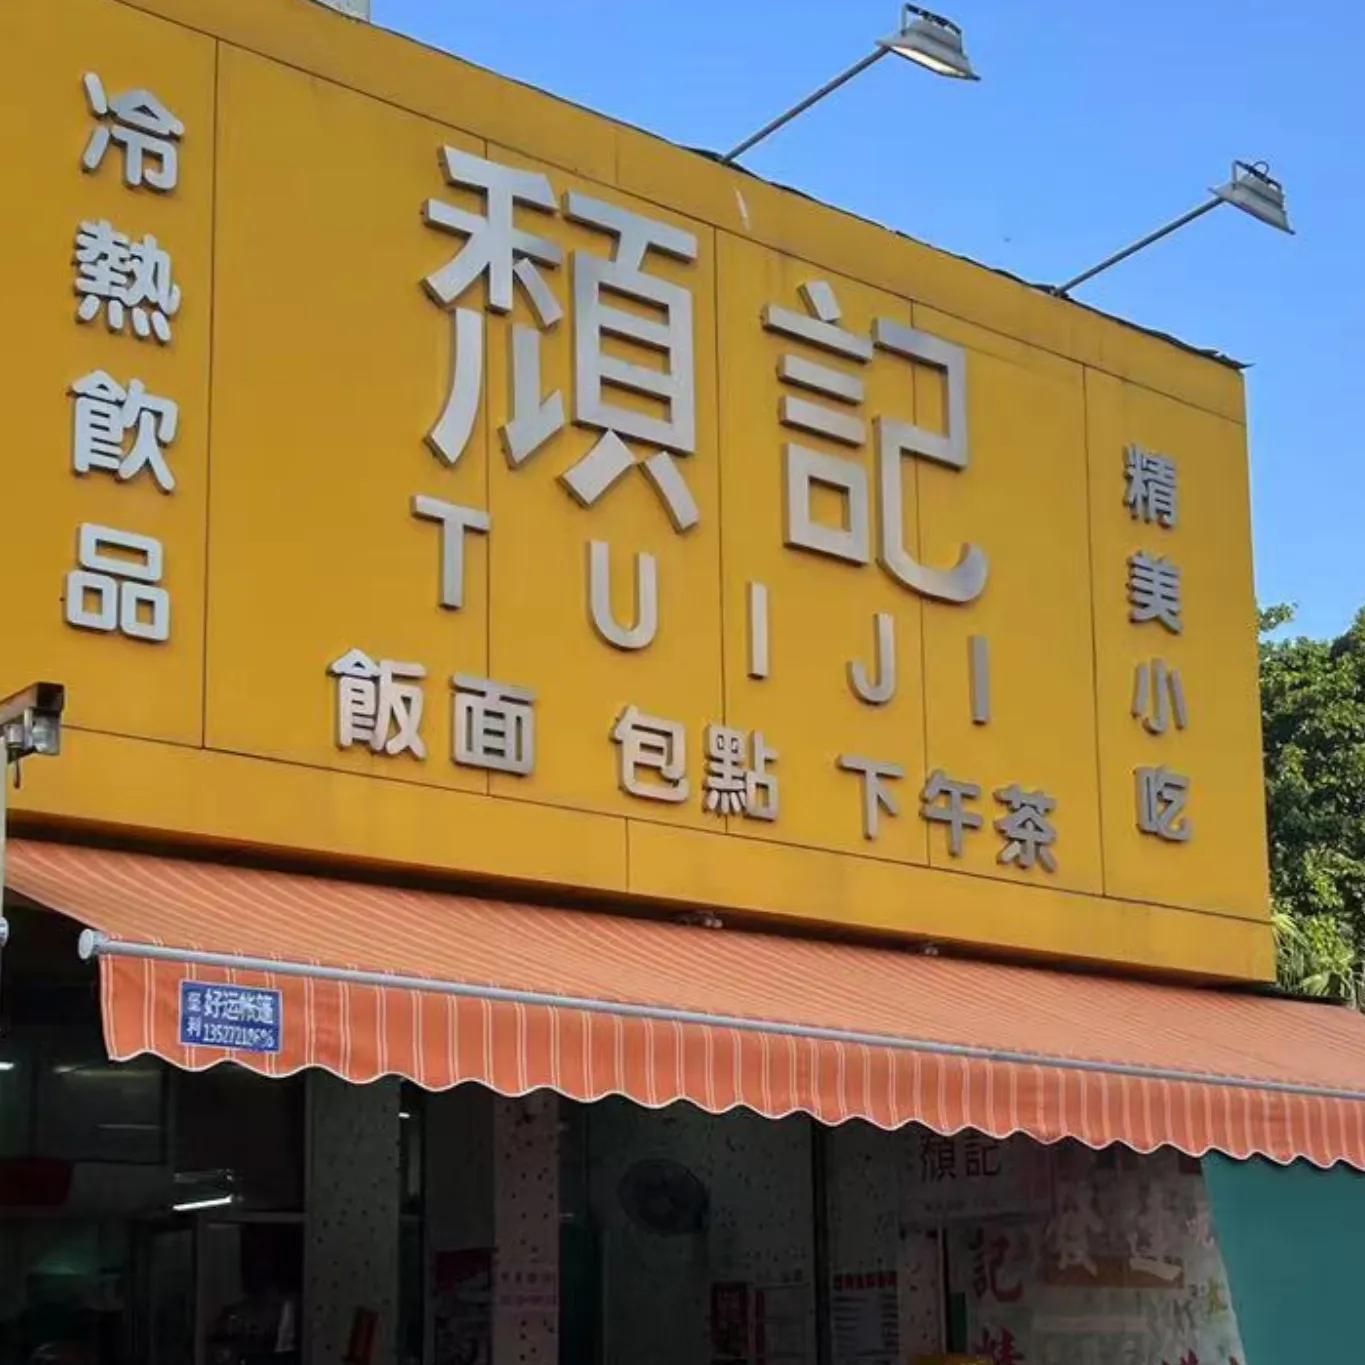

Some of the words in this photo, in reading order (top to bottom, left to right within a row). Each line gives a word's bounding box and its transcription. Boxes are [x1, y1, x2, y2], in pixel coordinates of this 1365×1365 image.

[65, 71, 185, 643] 冷熱飲品
[330, 648, 536, 777] 飯面
[612, 704, 780, 822] 包點
[837, 752, 1058, 873] 下午茶
[1124, 442, 1192, 844] 精美小吃
